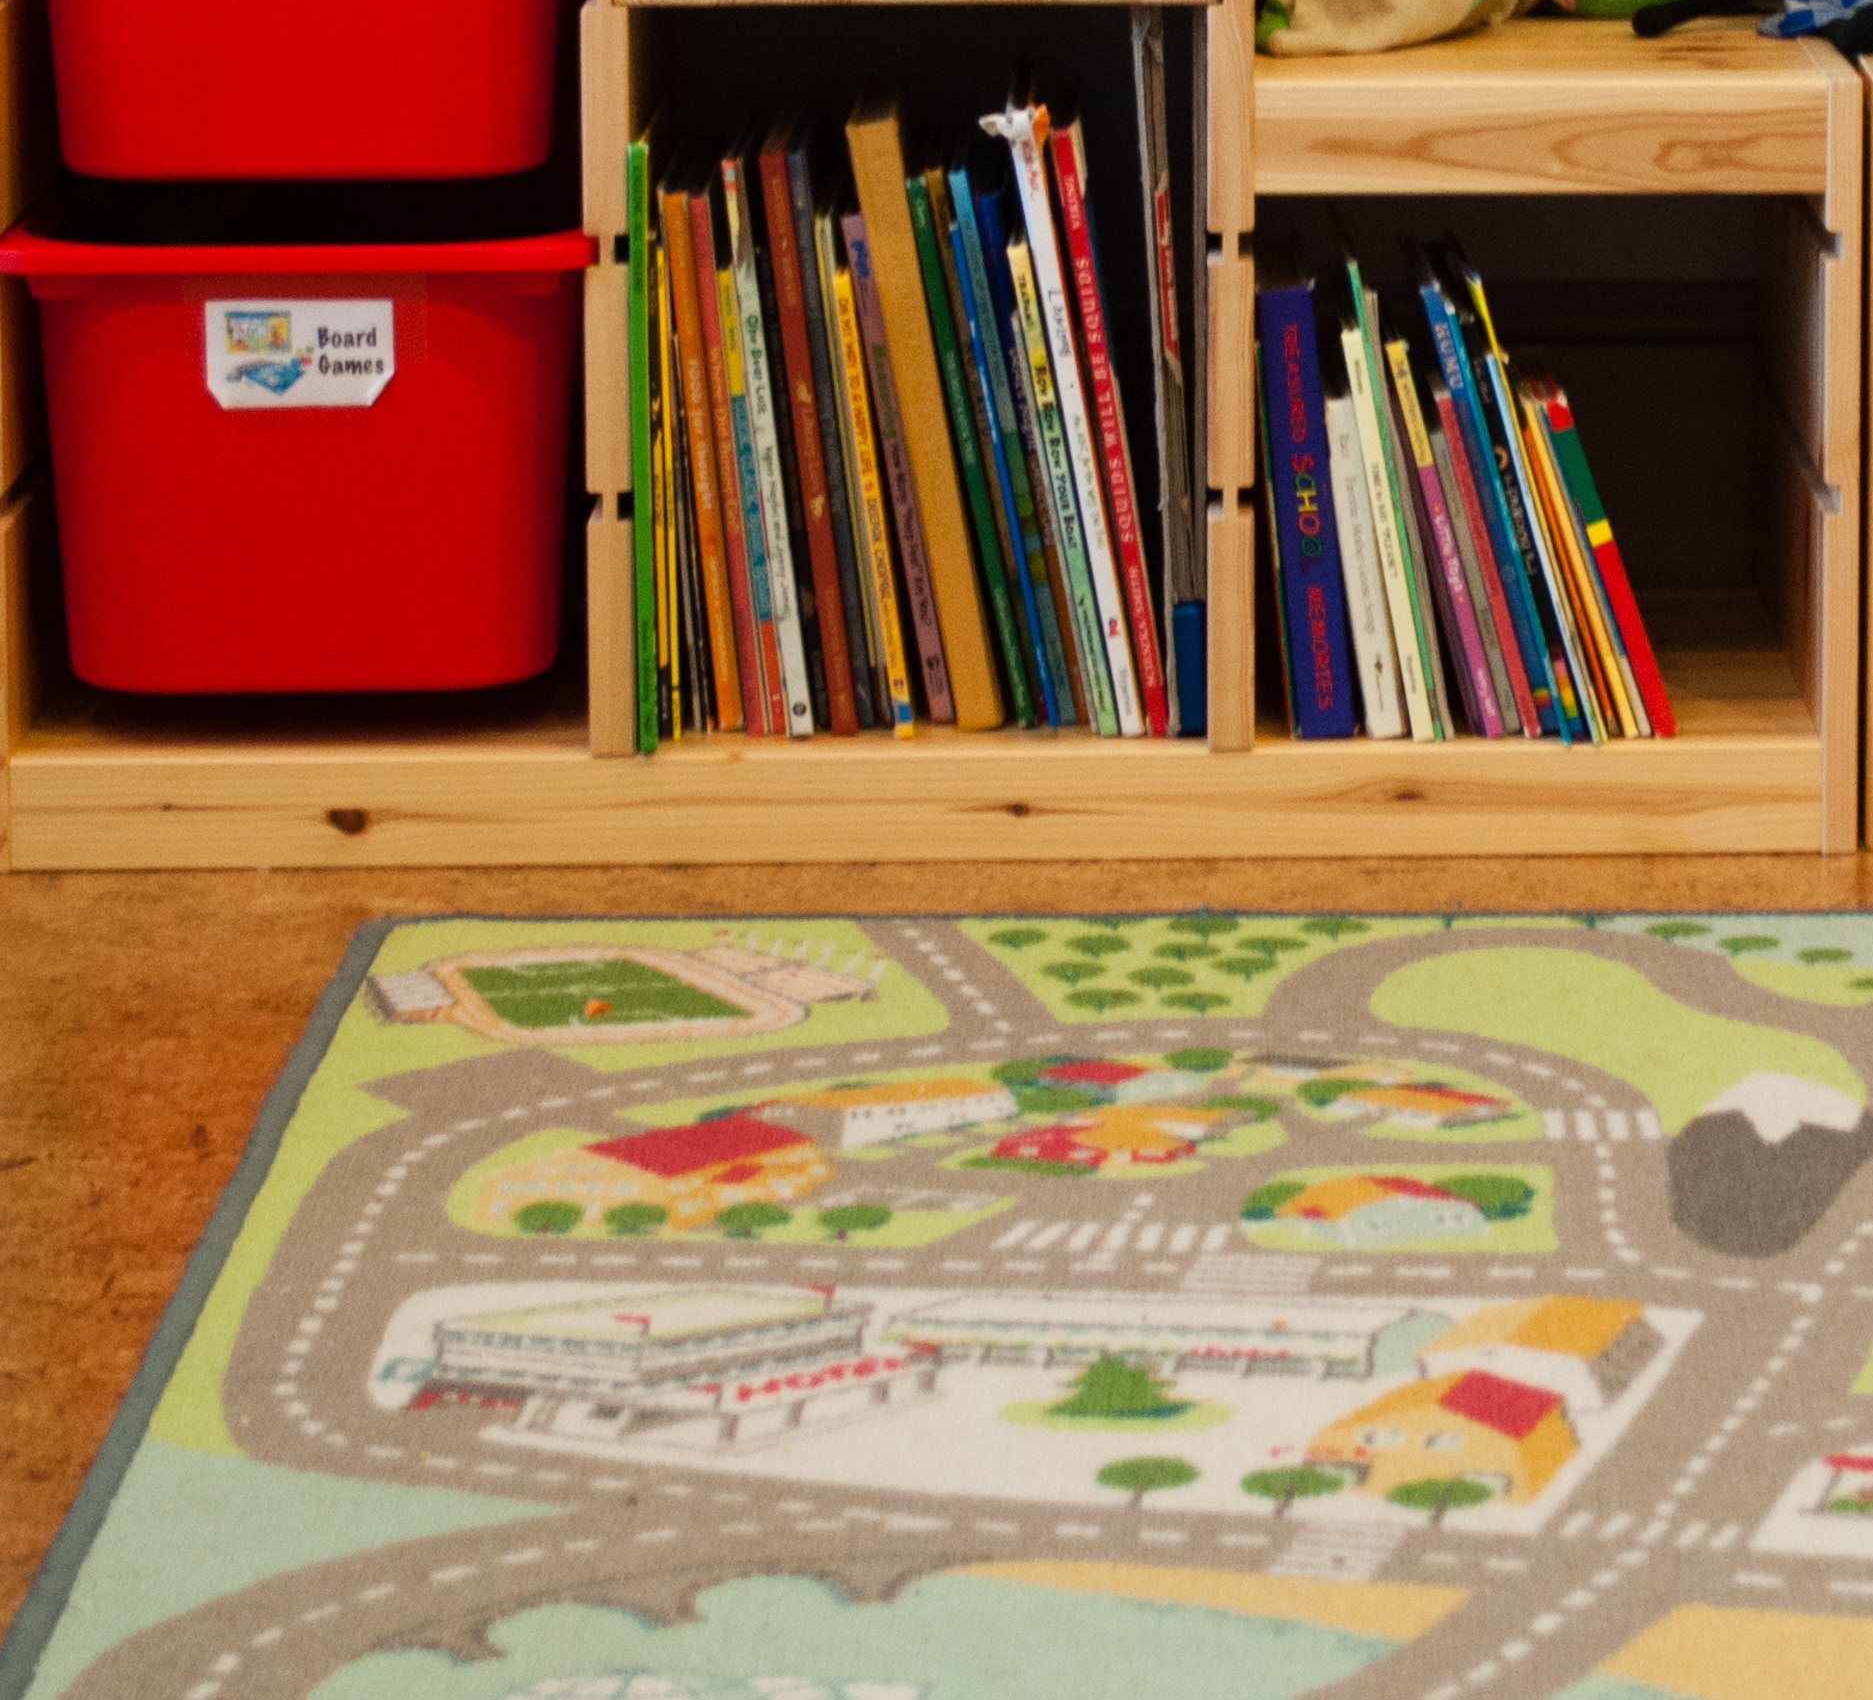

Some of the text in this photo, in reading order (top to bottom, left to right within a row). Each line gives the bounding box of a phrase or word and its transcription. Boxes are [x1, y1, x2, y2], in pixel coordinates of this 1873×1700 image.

[318, 326, 377, 348] Board
[318, 354, 385, 376] Games
[1075, 254, 1135, 545] SQUIDS WILL BE SQUIDS
[1280, 322, 1334, 711] TREASURED SCHOOL MEMORIES
